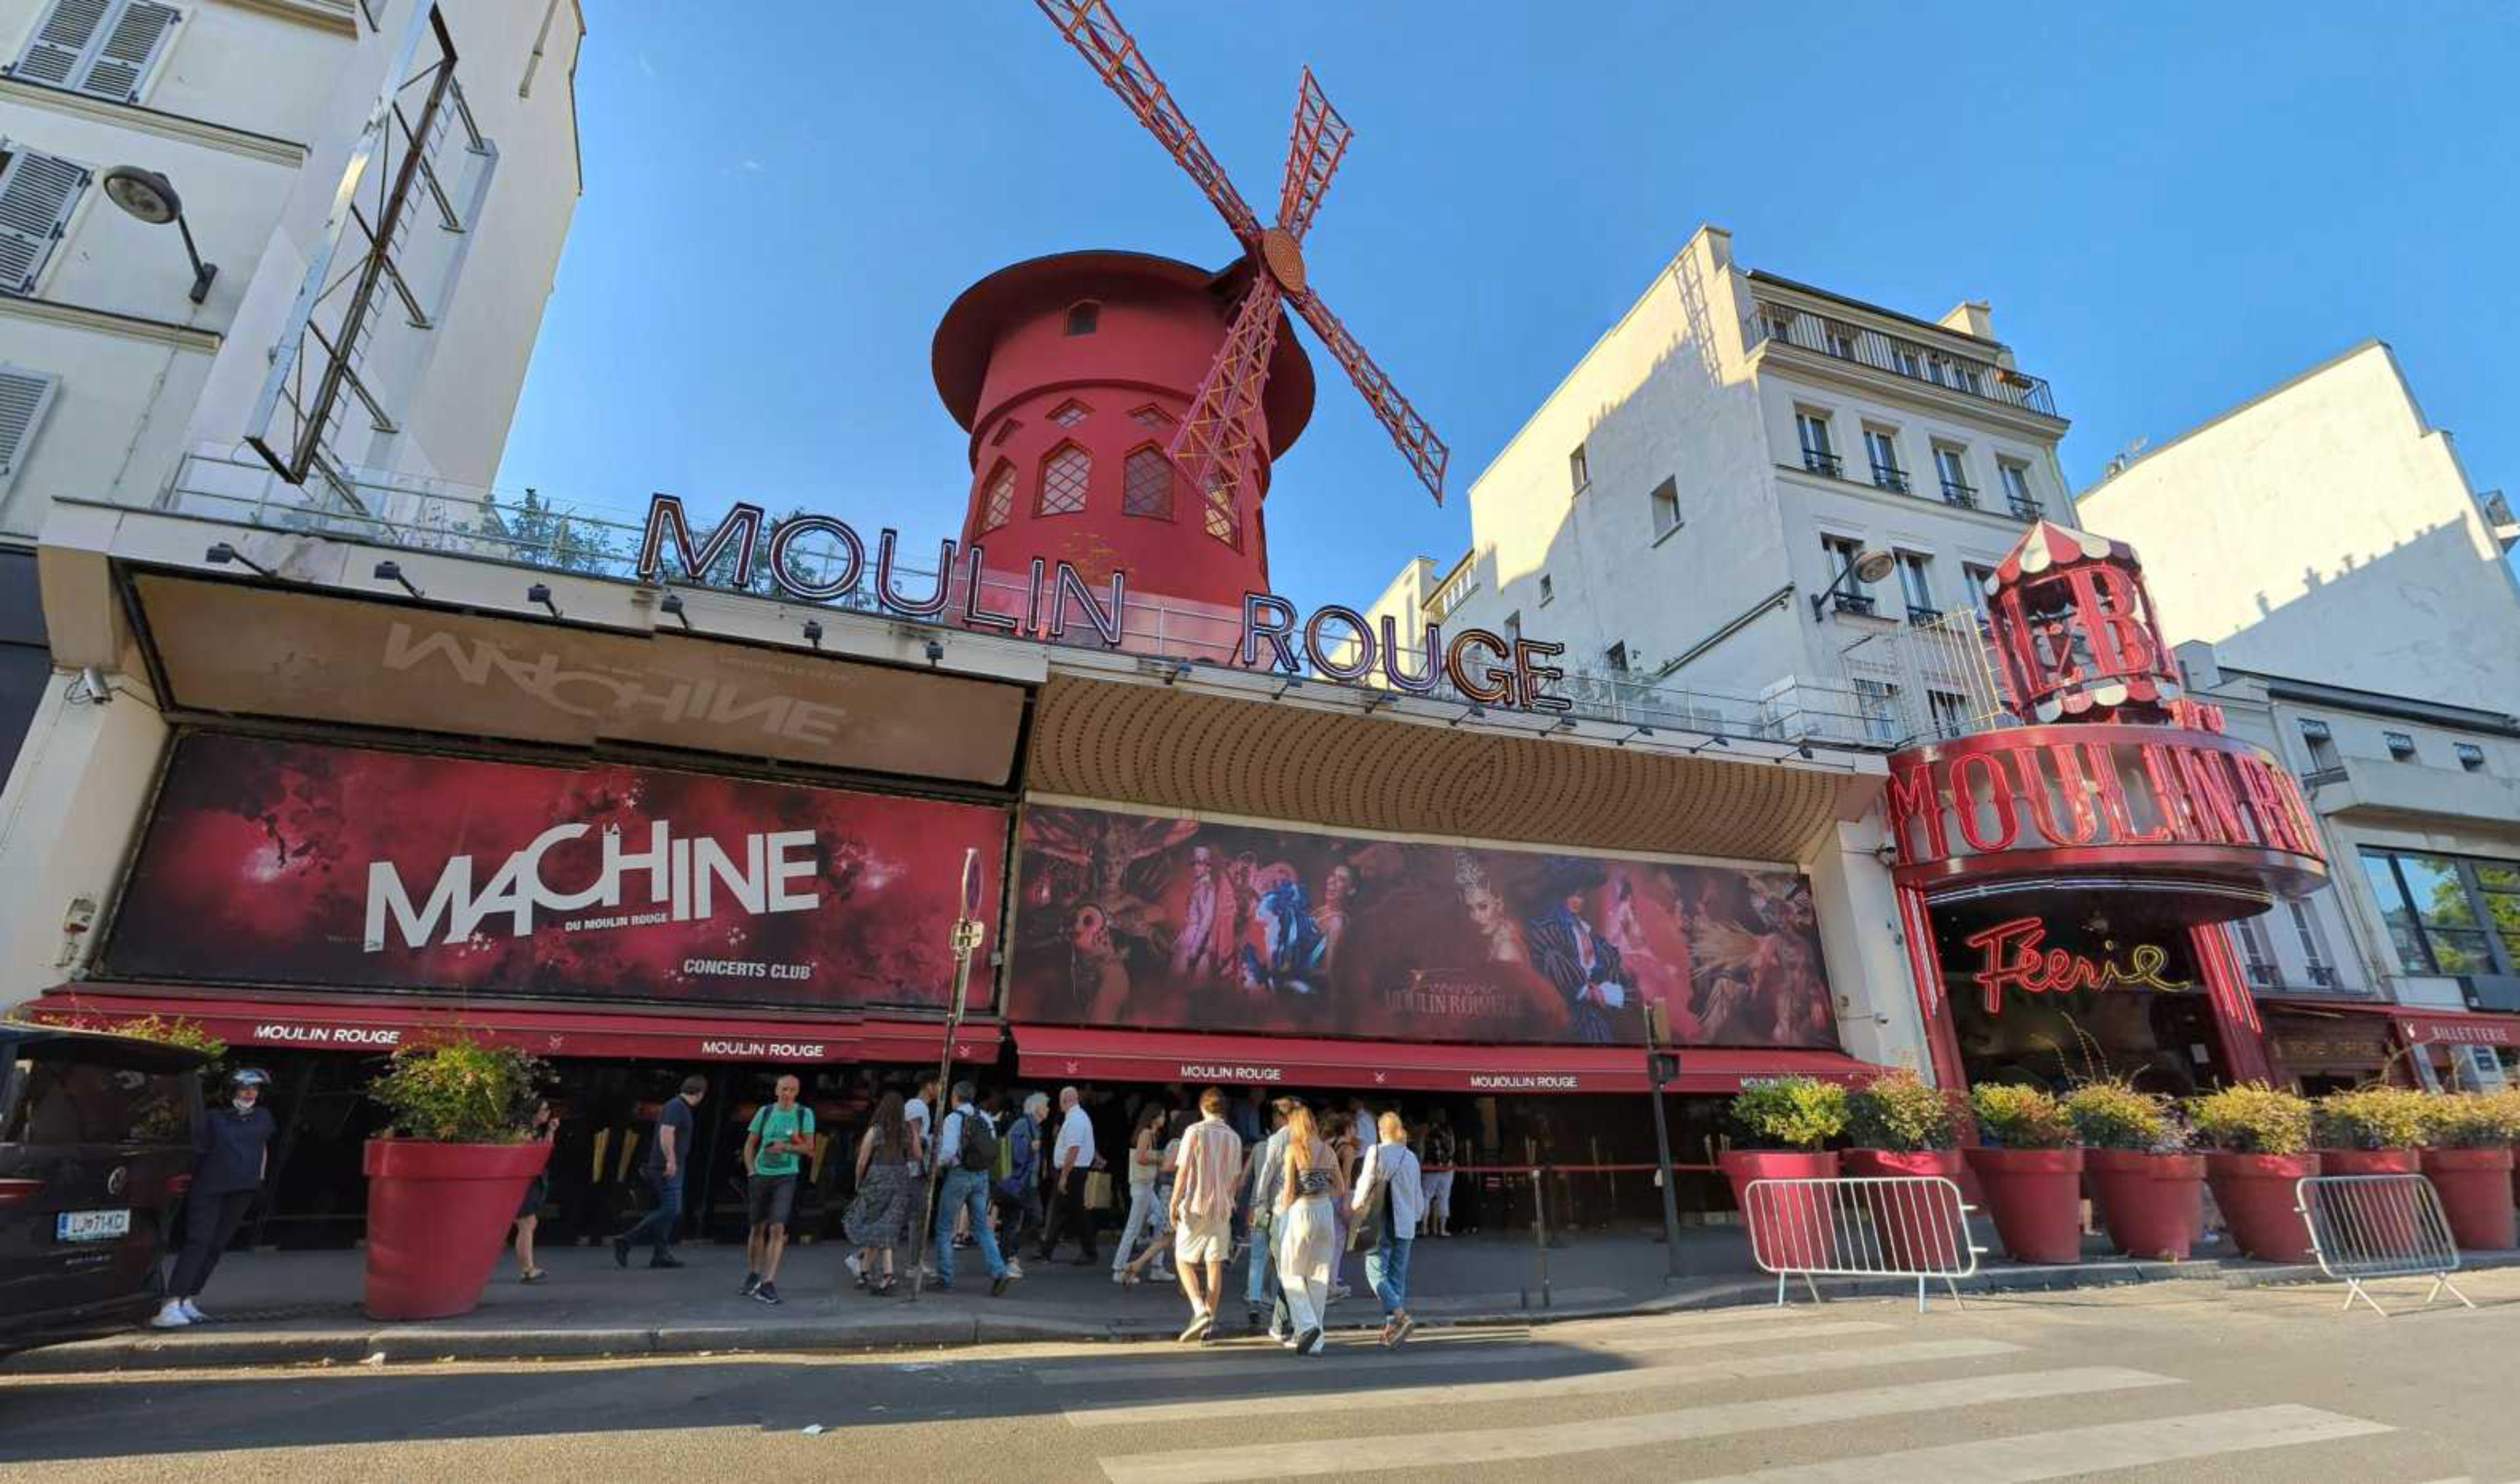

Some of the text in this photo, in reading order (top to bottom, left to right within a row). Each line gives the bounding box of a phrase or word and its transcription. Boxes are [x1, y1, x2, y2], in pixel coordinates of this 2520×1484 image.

[637, 493, 1572, 711] MOULIN ROUGE
[1886, 744, 2250, 865] MOULIN
[363, 820, 820, 953] MACHINE
[564, 913, 668, 932] DU MOULIN ROUGE
[683, 958, 811, 979] CONCERTS CLUB
[254, 1024, 401, 1044] MOULIN ROUGE
[2431, 1025, 2510, 1042] BILLETTERIE
[702, 1041, 824, 1057] MOULIN ROUGE
[1181, 1065, 1282, 1081] MOULIN ROUGE
[1537, 1076, 1578, 1088] ROUGE
